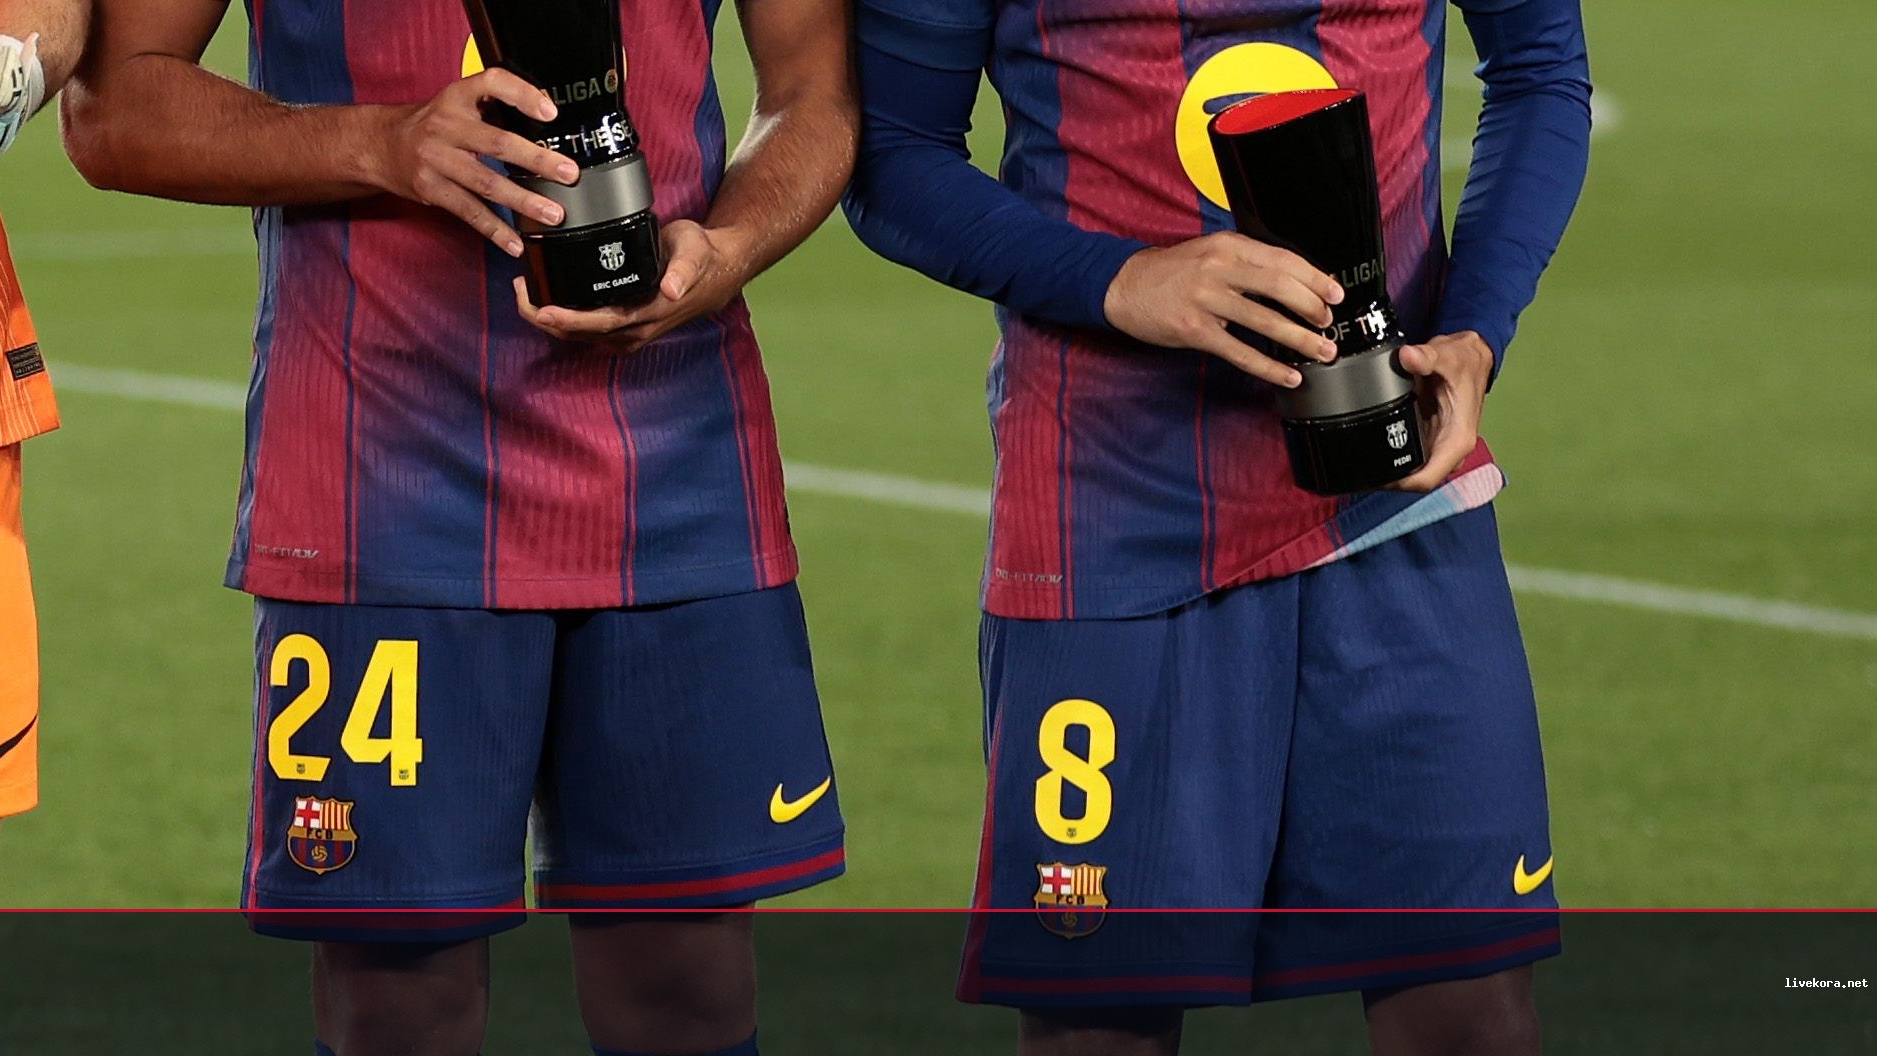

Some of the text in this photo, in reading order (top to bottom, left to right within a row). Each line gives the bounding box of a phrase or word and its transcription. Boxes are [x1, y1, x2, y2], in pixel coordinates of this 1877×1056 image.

[593, 280, 611, 291] ERIC
[268, 633, 423, 787] 24
[1035, 698, 1116, 845] 8
[306, 828, 334, 840] FCB
